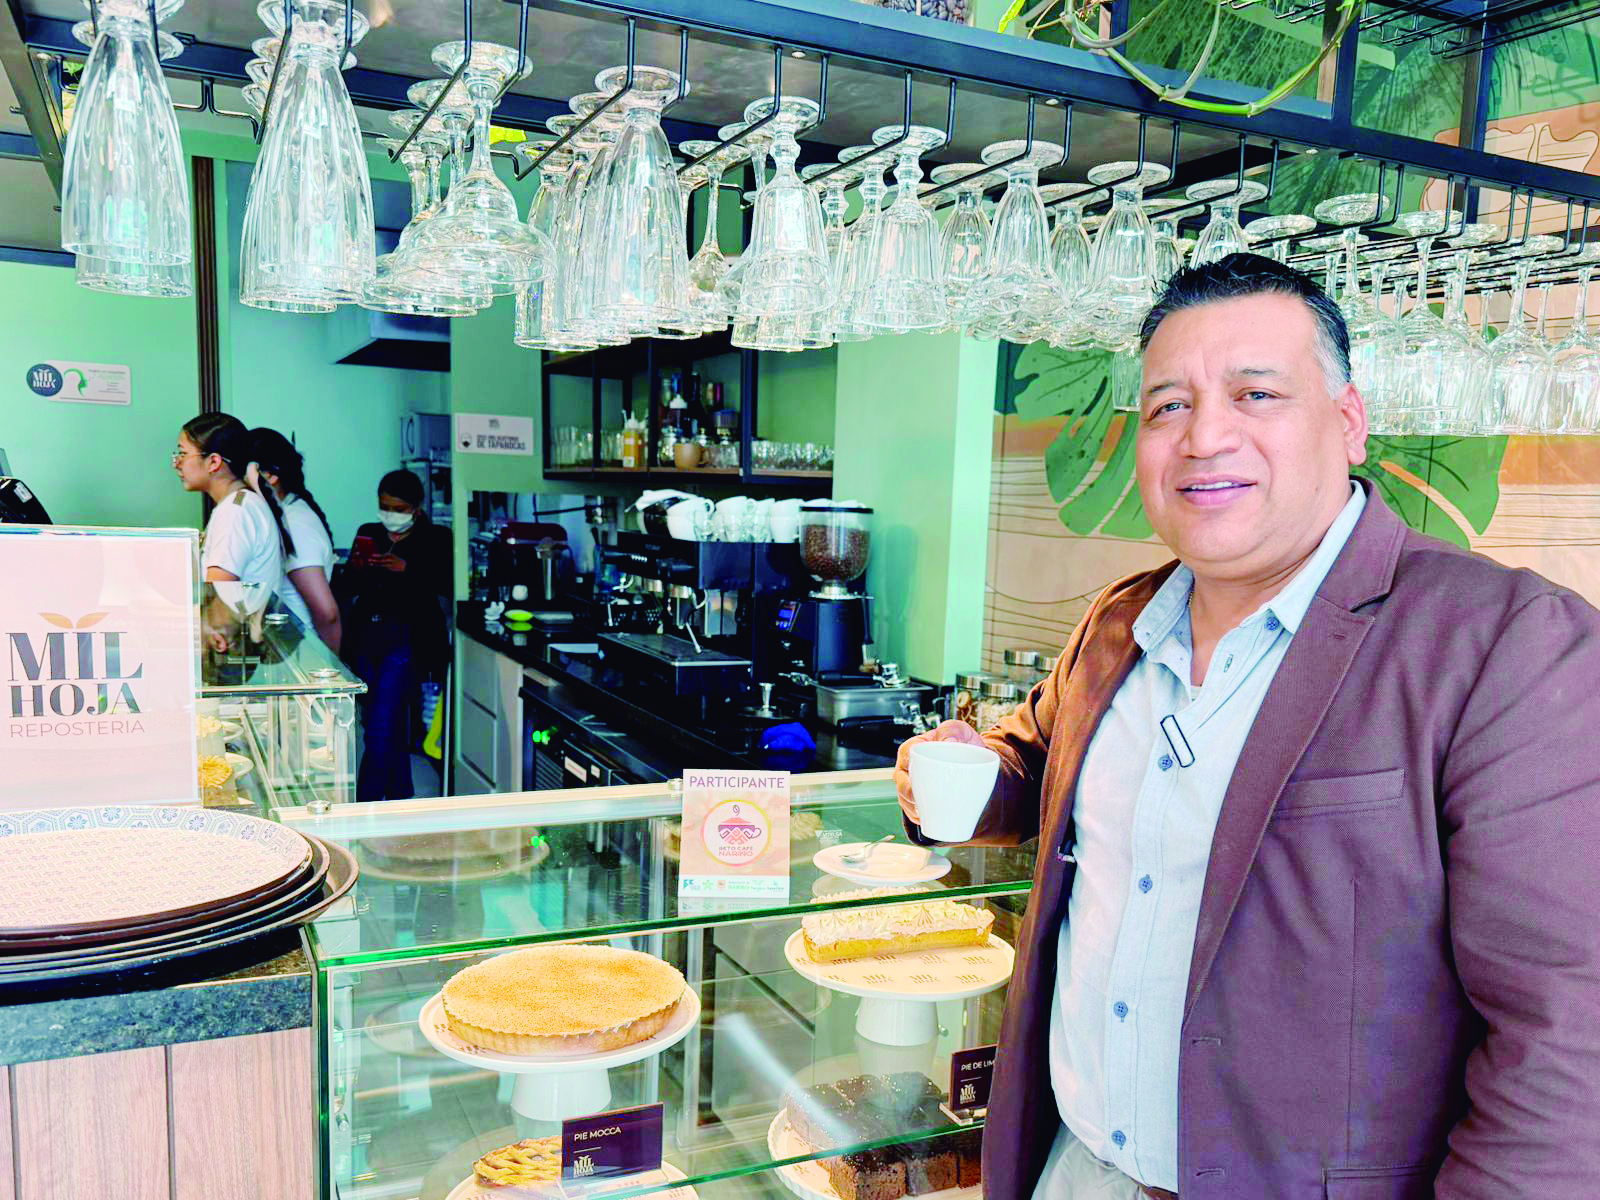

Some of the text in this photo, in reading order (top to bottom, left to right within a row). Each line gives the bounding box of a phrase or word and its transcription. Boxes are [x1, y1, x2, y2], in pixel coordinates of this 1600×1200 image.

[5, 631, 143, 681] MIL
[7, 682, 142, 718] HOJA
[10, 720, 145, 738] REPOSTERIA
[689, 775, 785, 788] PARTICIPANTE
[961, 1063, 972, 1071] PIE
[973, 1061, 982, 1069] DE
[574, 1126, 622, 1141] PIE MOCCA
